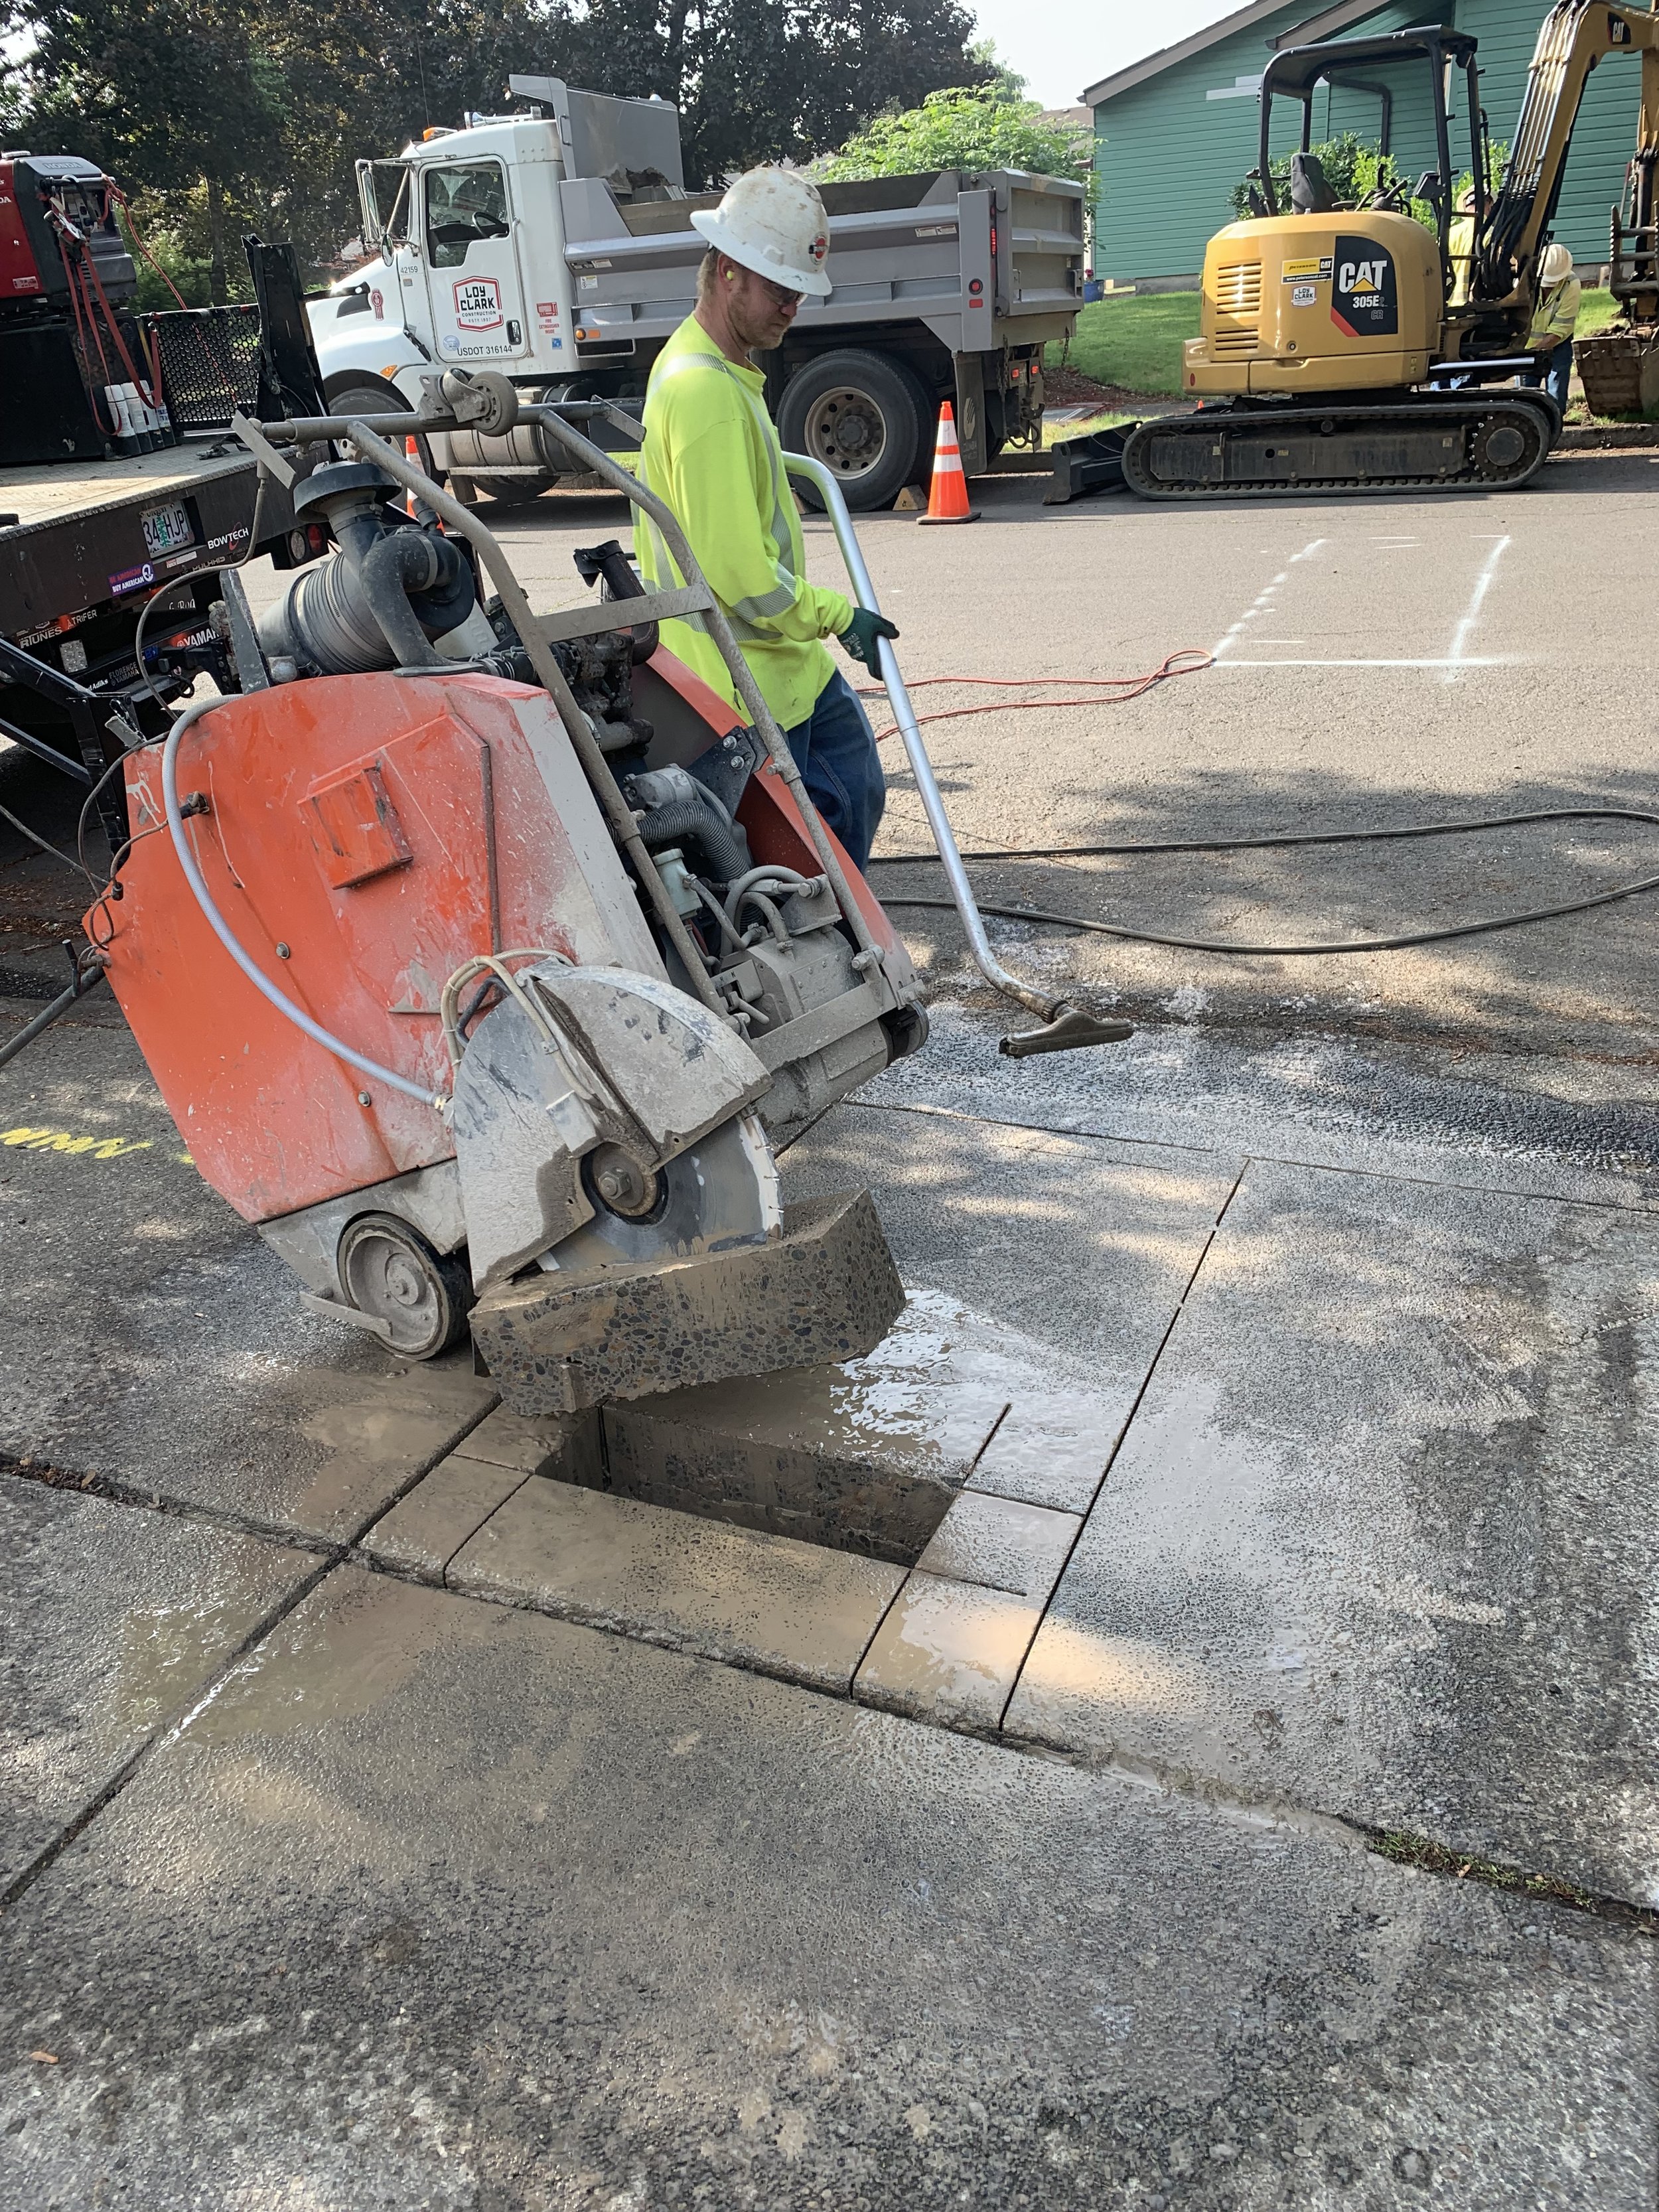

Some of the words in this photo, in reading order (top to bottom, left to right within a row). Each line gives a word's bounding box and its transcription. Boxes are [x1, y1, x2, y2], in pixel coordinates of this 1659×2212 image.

[1339, 260, 1387, 293] CAT
[465, 285, 486, 298] LOY
[460, 297, 495, 311] CLARK
[457, 346, 484, 356] USDOT
[486, 344, 512, 355] 316144
[207, 528, 250, 550] BOWTECH
[112, 583, 121, 593] BUY
[122, 576, 145, 589] AMERICAN
[183, 627, 220, 646] YAMAH
[109, 662, 137, 679] FLORENCE
[115, 668, 140, 683] YAMAHA
